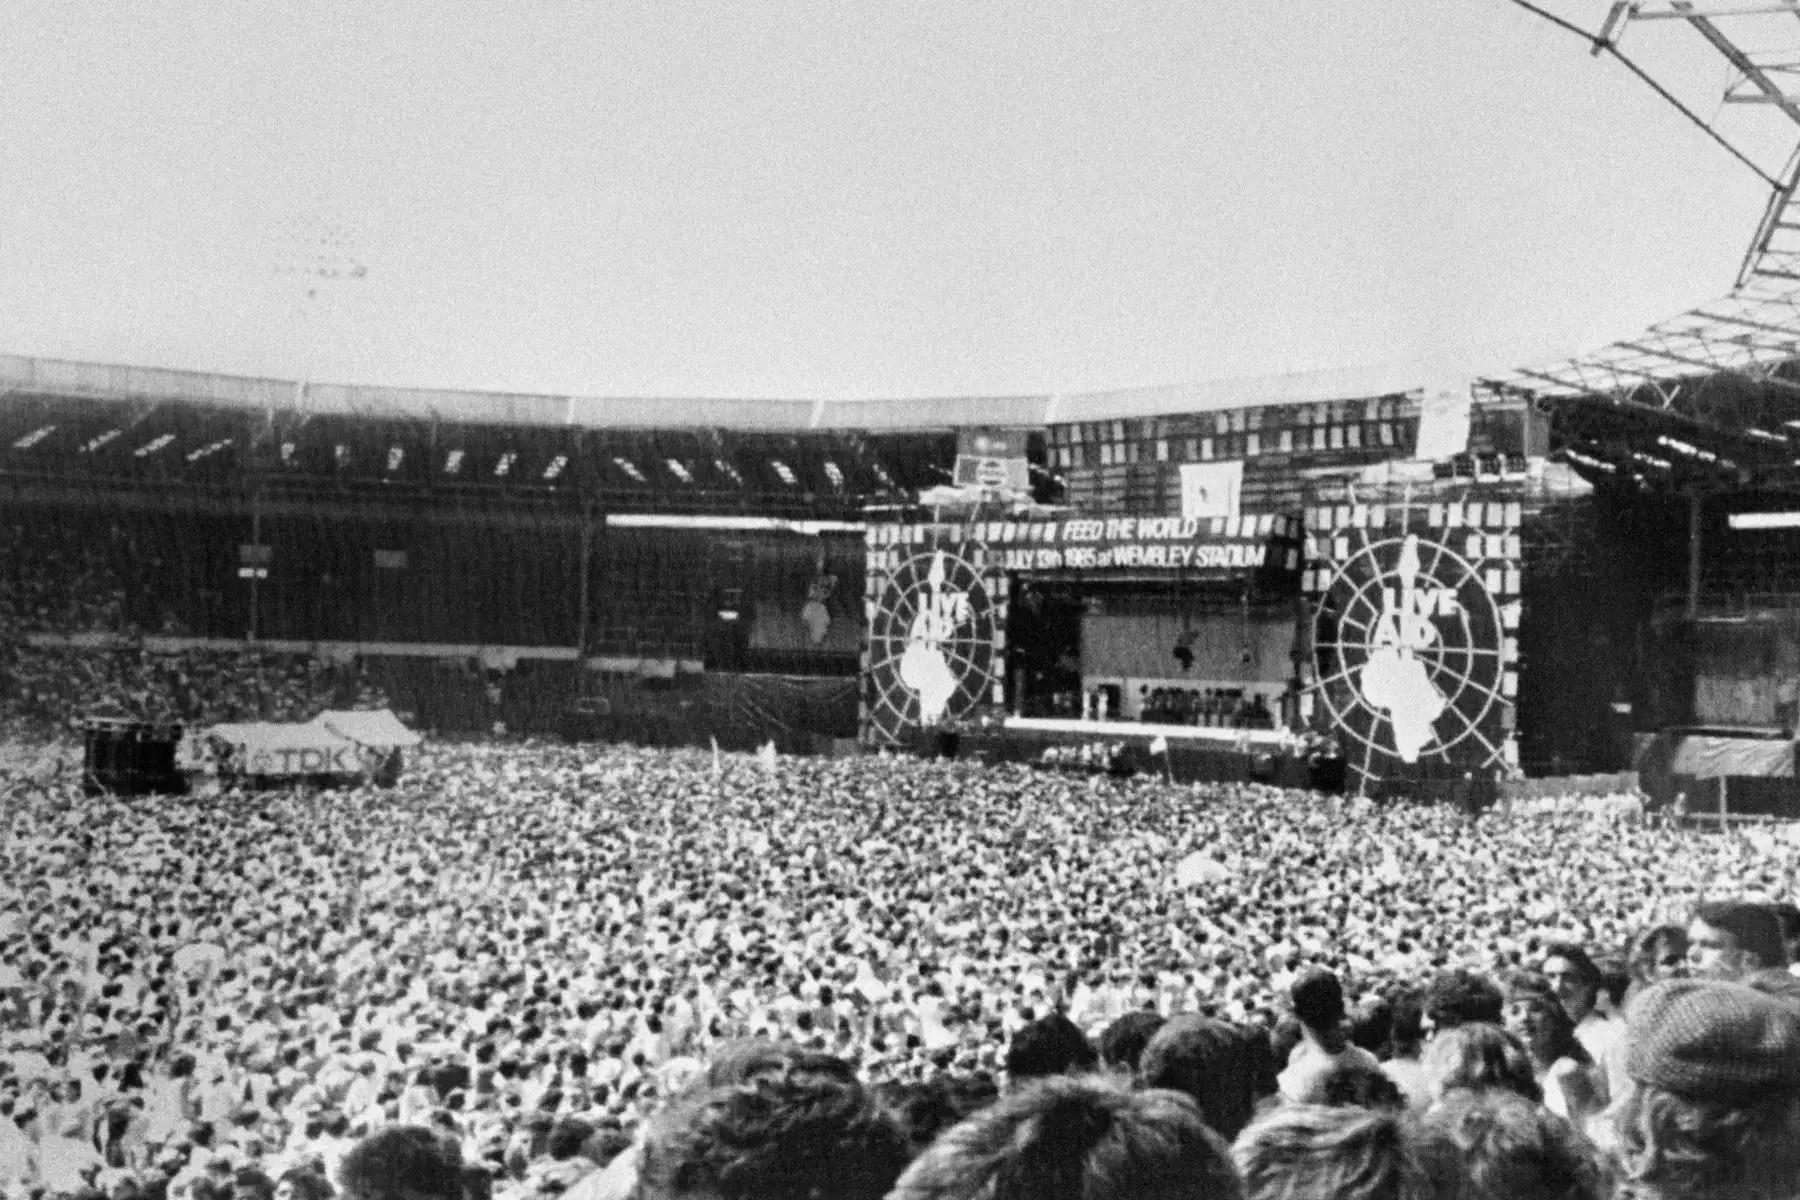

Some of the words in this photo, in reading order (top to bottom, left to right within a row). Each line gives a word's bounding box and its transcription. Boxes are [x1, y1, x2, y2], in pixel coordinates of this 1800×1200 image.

[1062, 519, 1103, 541] FEED
[1106, 518, 1138, 540] THE
[1138, 515, 1197, 539] WORLD
[1113, 544, 1194, 568] WEMBLEY
[1195, 544, 1266, 567] STADIUM
[918, 591, 969, 623] LIVE
[1382, 587, 1458, 617] LIVE
[275, 748, 350, 773] TDK
